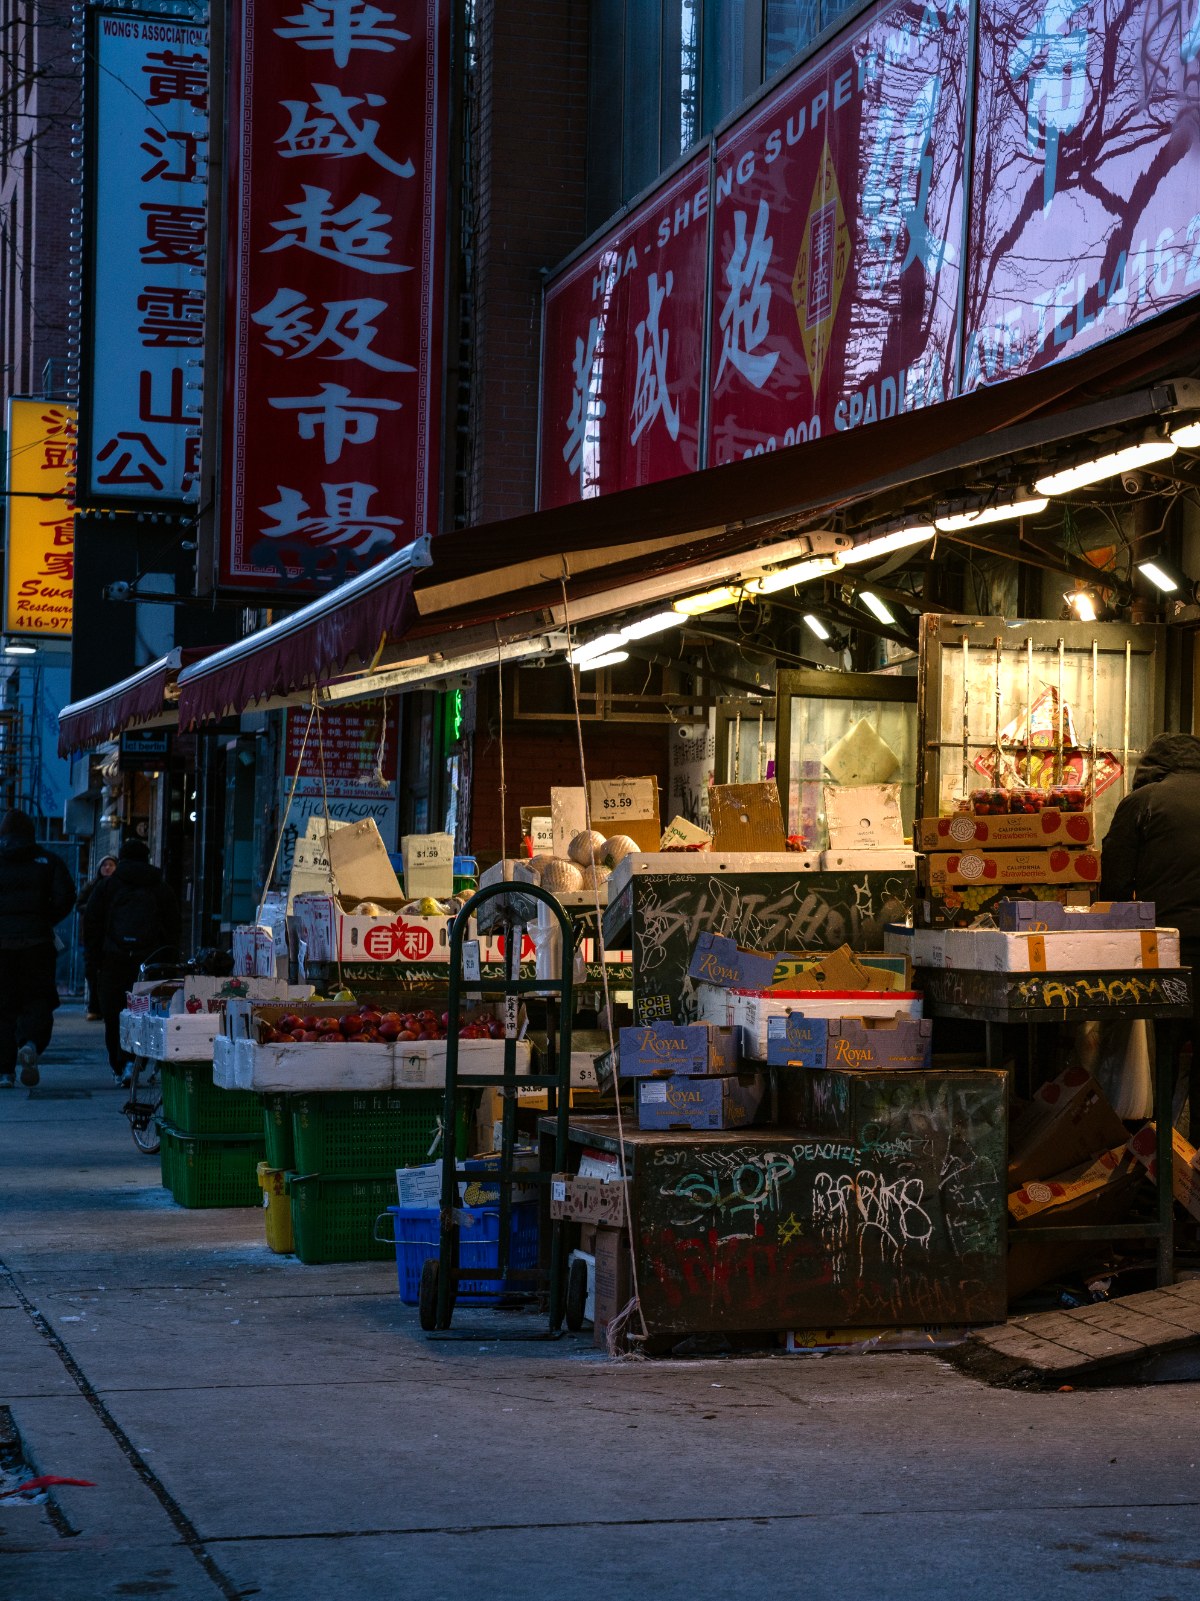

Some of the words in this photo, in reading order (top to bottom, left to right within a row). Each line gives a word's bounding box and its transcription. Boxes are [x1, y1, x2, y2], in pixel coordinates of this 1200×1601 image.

[103, 20, 139, 39] WONG'S
[142, 25, 202, 45] ASSOCIATION
[657, 150, 755, 248] SHENG
[603, 797, 632, 809] $3.59
[537, 832, 553, 840] $0.9
[417, 850, 439, 859] $1.59
[1001, 870, 1046, 878] Strawberries
